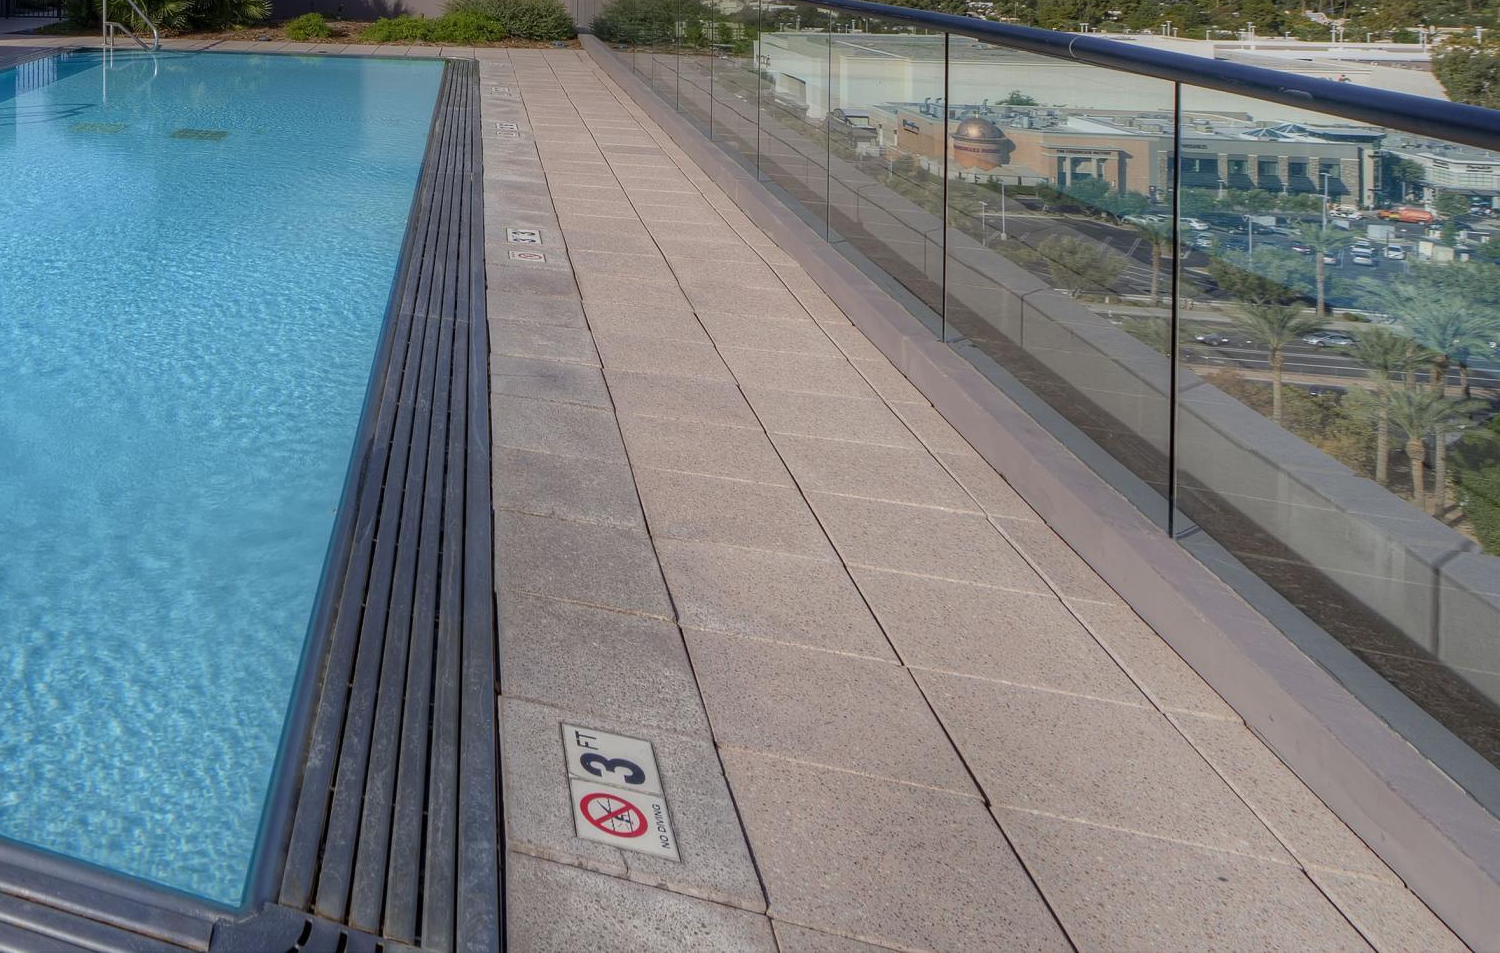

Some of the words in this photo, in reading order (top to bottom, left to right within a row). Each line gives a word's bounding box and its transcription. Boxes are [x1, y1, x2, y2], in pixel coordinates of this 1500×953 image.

[574, 730, 599, 751] FT
[580, 752, 646, 785] 3
[652, 804, 666, 833] DIVING
[659, 836, 672, 850] NO
